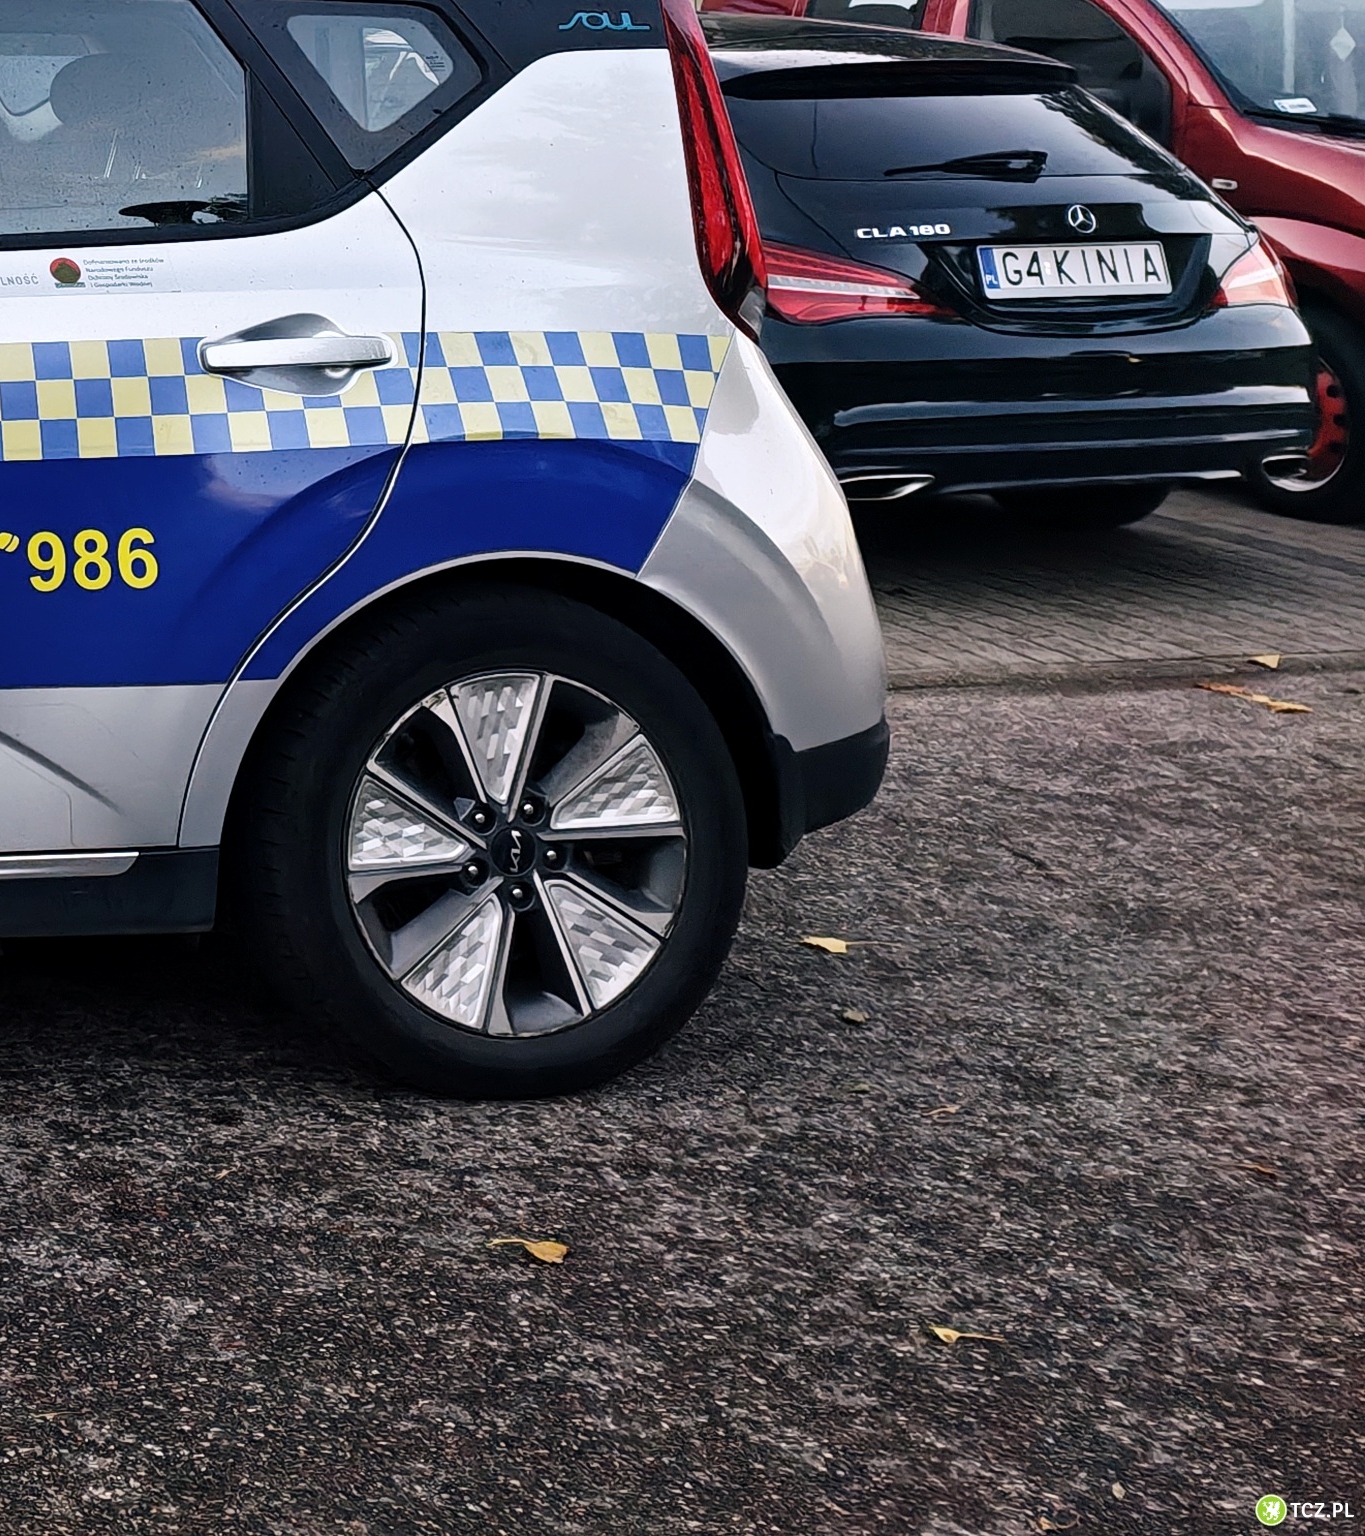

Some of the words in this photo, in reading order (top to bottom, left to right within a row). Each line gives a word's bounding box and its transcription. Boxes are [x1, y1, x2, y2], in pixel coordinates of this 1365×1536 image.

[856, 226, 906, 239] CLA
[909, 223, 951, 236] 180
[986, 274, 998, 285] PL
[27, 527, 159, 593] 986
